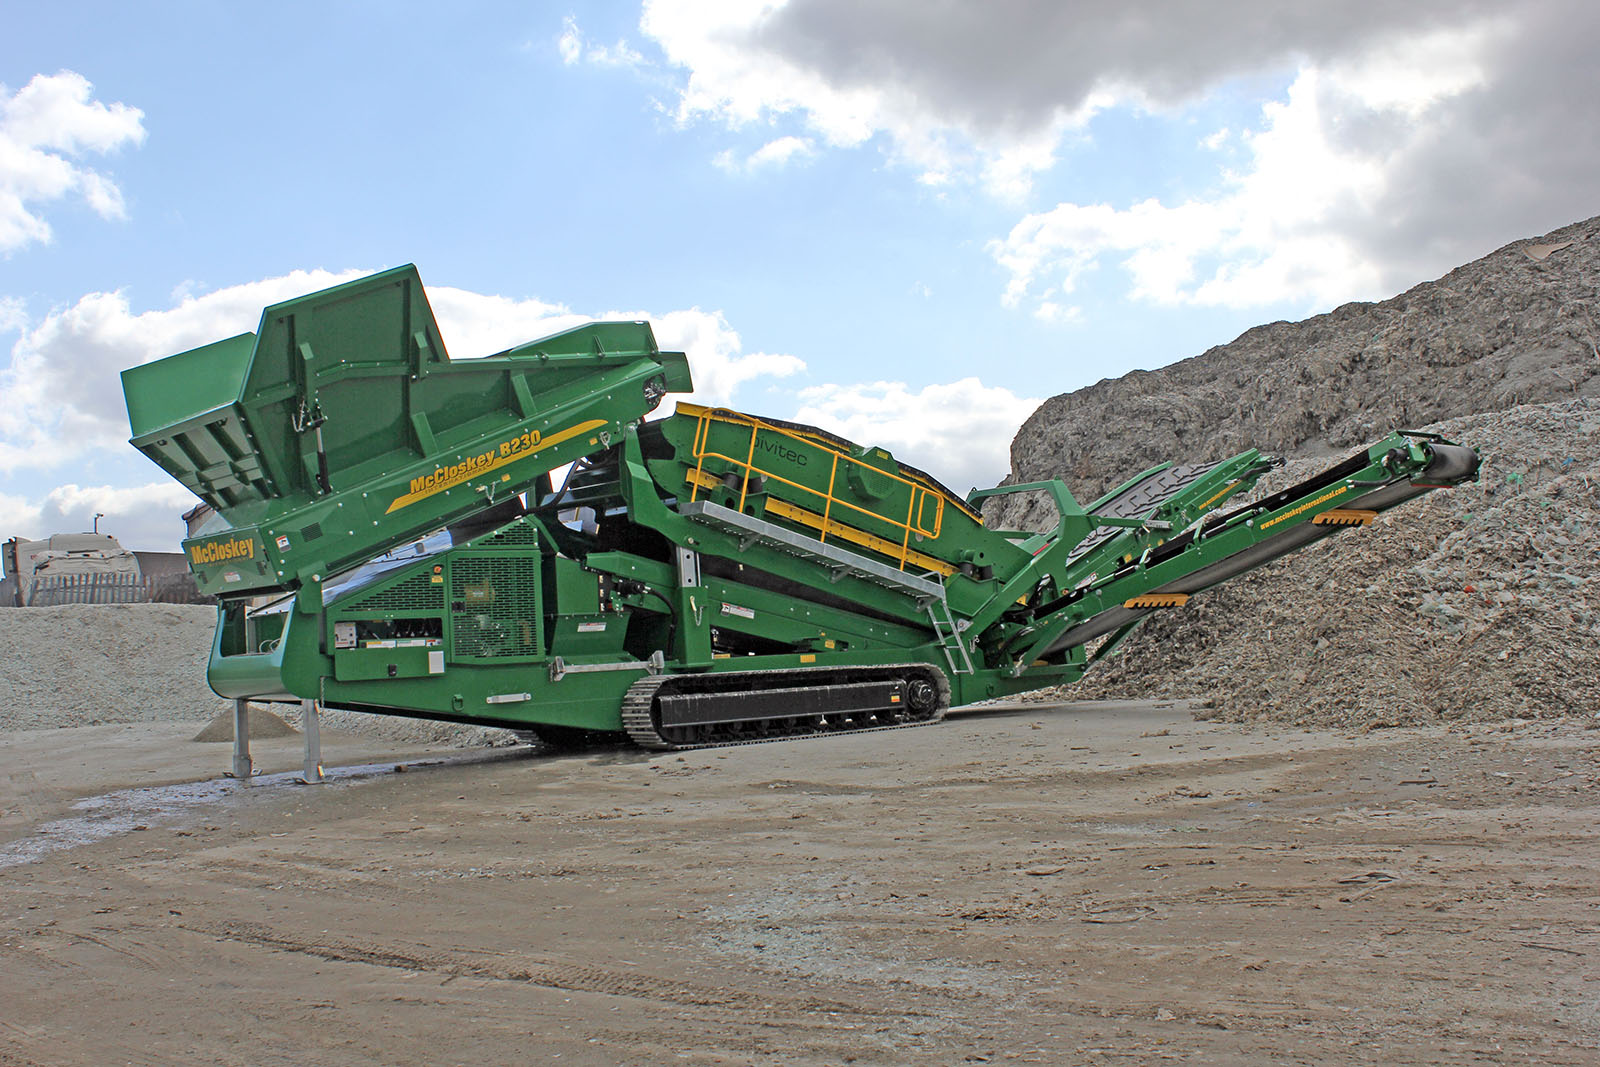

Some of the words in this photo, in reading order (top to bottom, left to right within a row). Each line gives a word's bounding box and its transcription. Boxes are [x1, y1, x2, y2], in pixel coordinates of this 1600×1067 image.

[410, 449, 496, 495] McCloskey
[499, 430, 541, 459] B230
[191, 538, 254, 564] McCloskey
